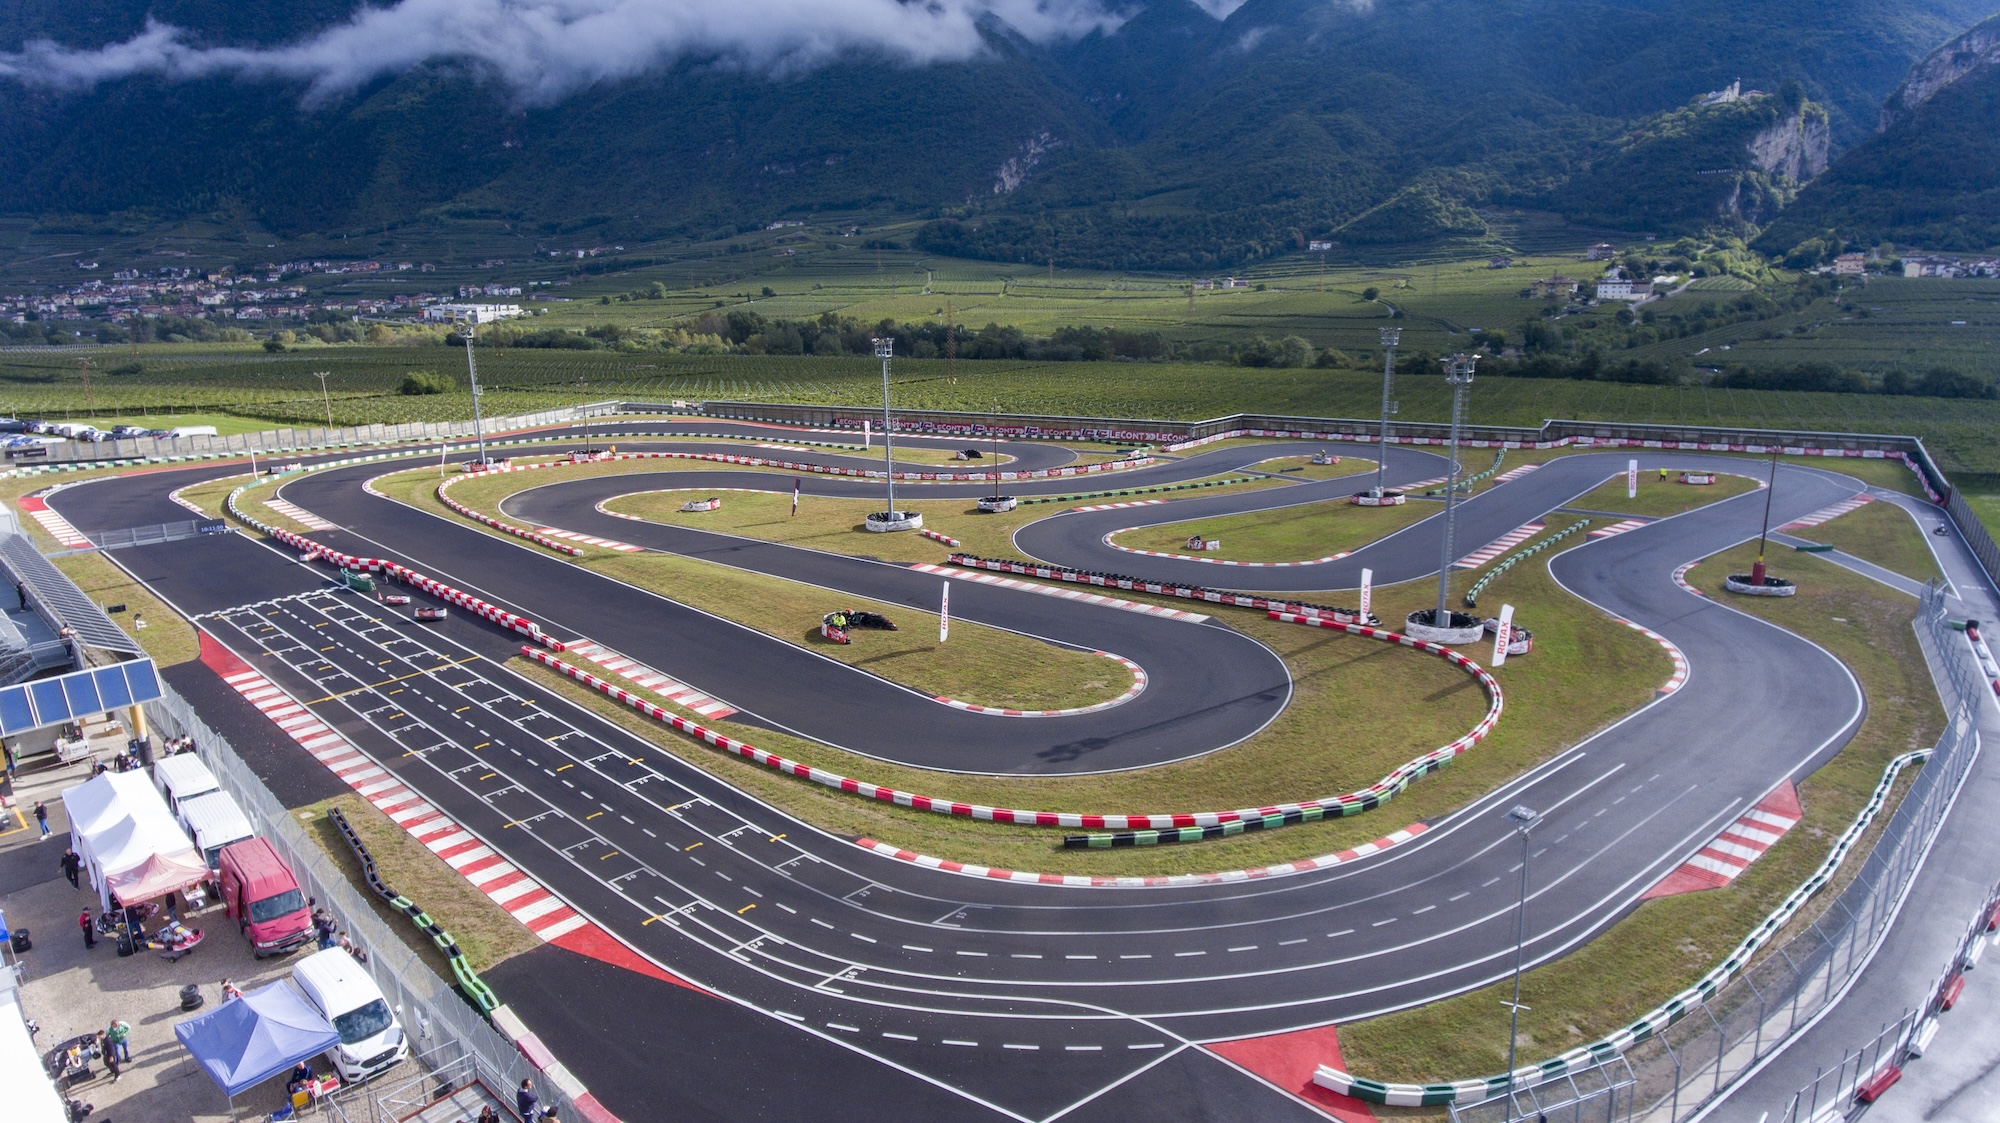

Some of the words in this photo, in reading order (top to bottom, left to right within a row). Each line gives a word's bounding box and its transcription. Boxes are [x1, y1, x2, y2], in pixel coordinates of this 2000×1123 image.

[1039, 428, 1070, 436] LECONT
[1110, 430, 1144, 440] LECONT
[1497, 621, 1509, 655] ROTAX
[789, 860, 800, 868] 31
[684, 906, 697, 914] 32
[956, 911, 967, 920] 35
[750, 941, 765, 950] 34
[845, 970, 859, 980] 36
